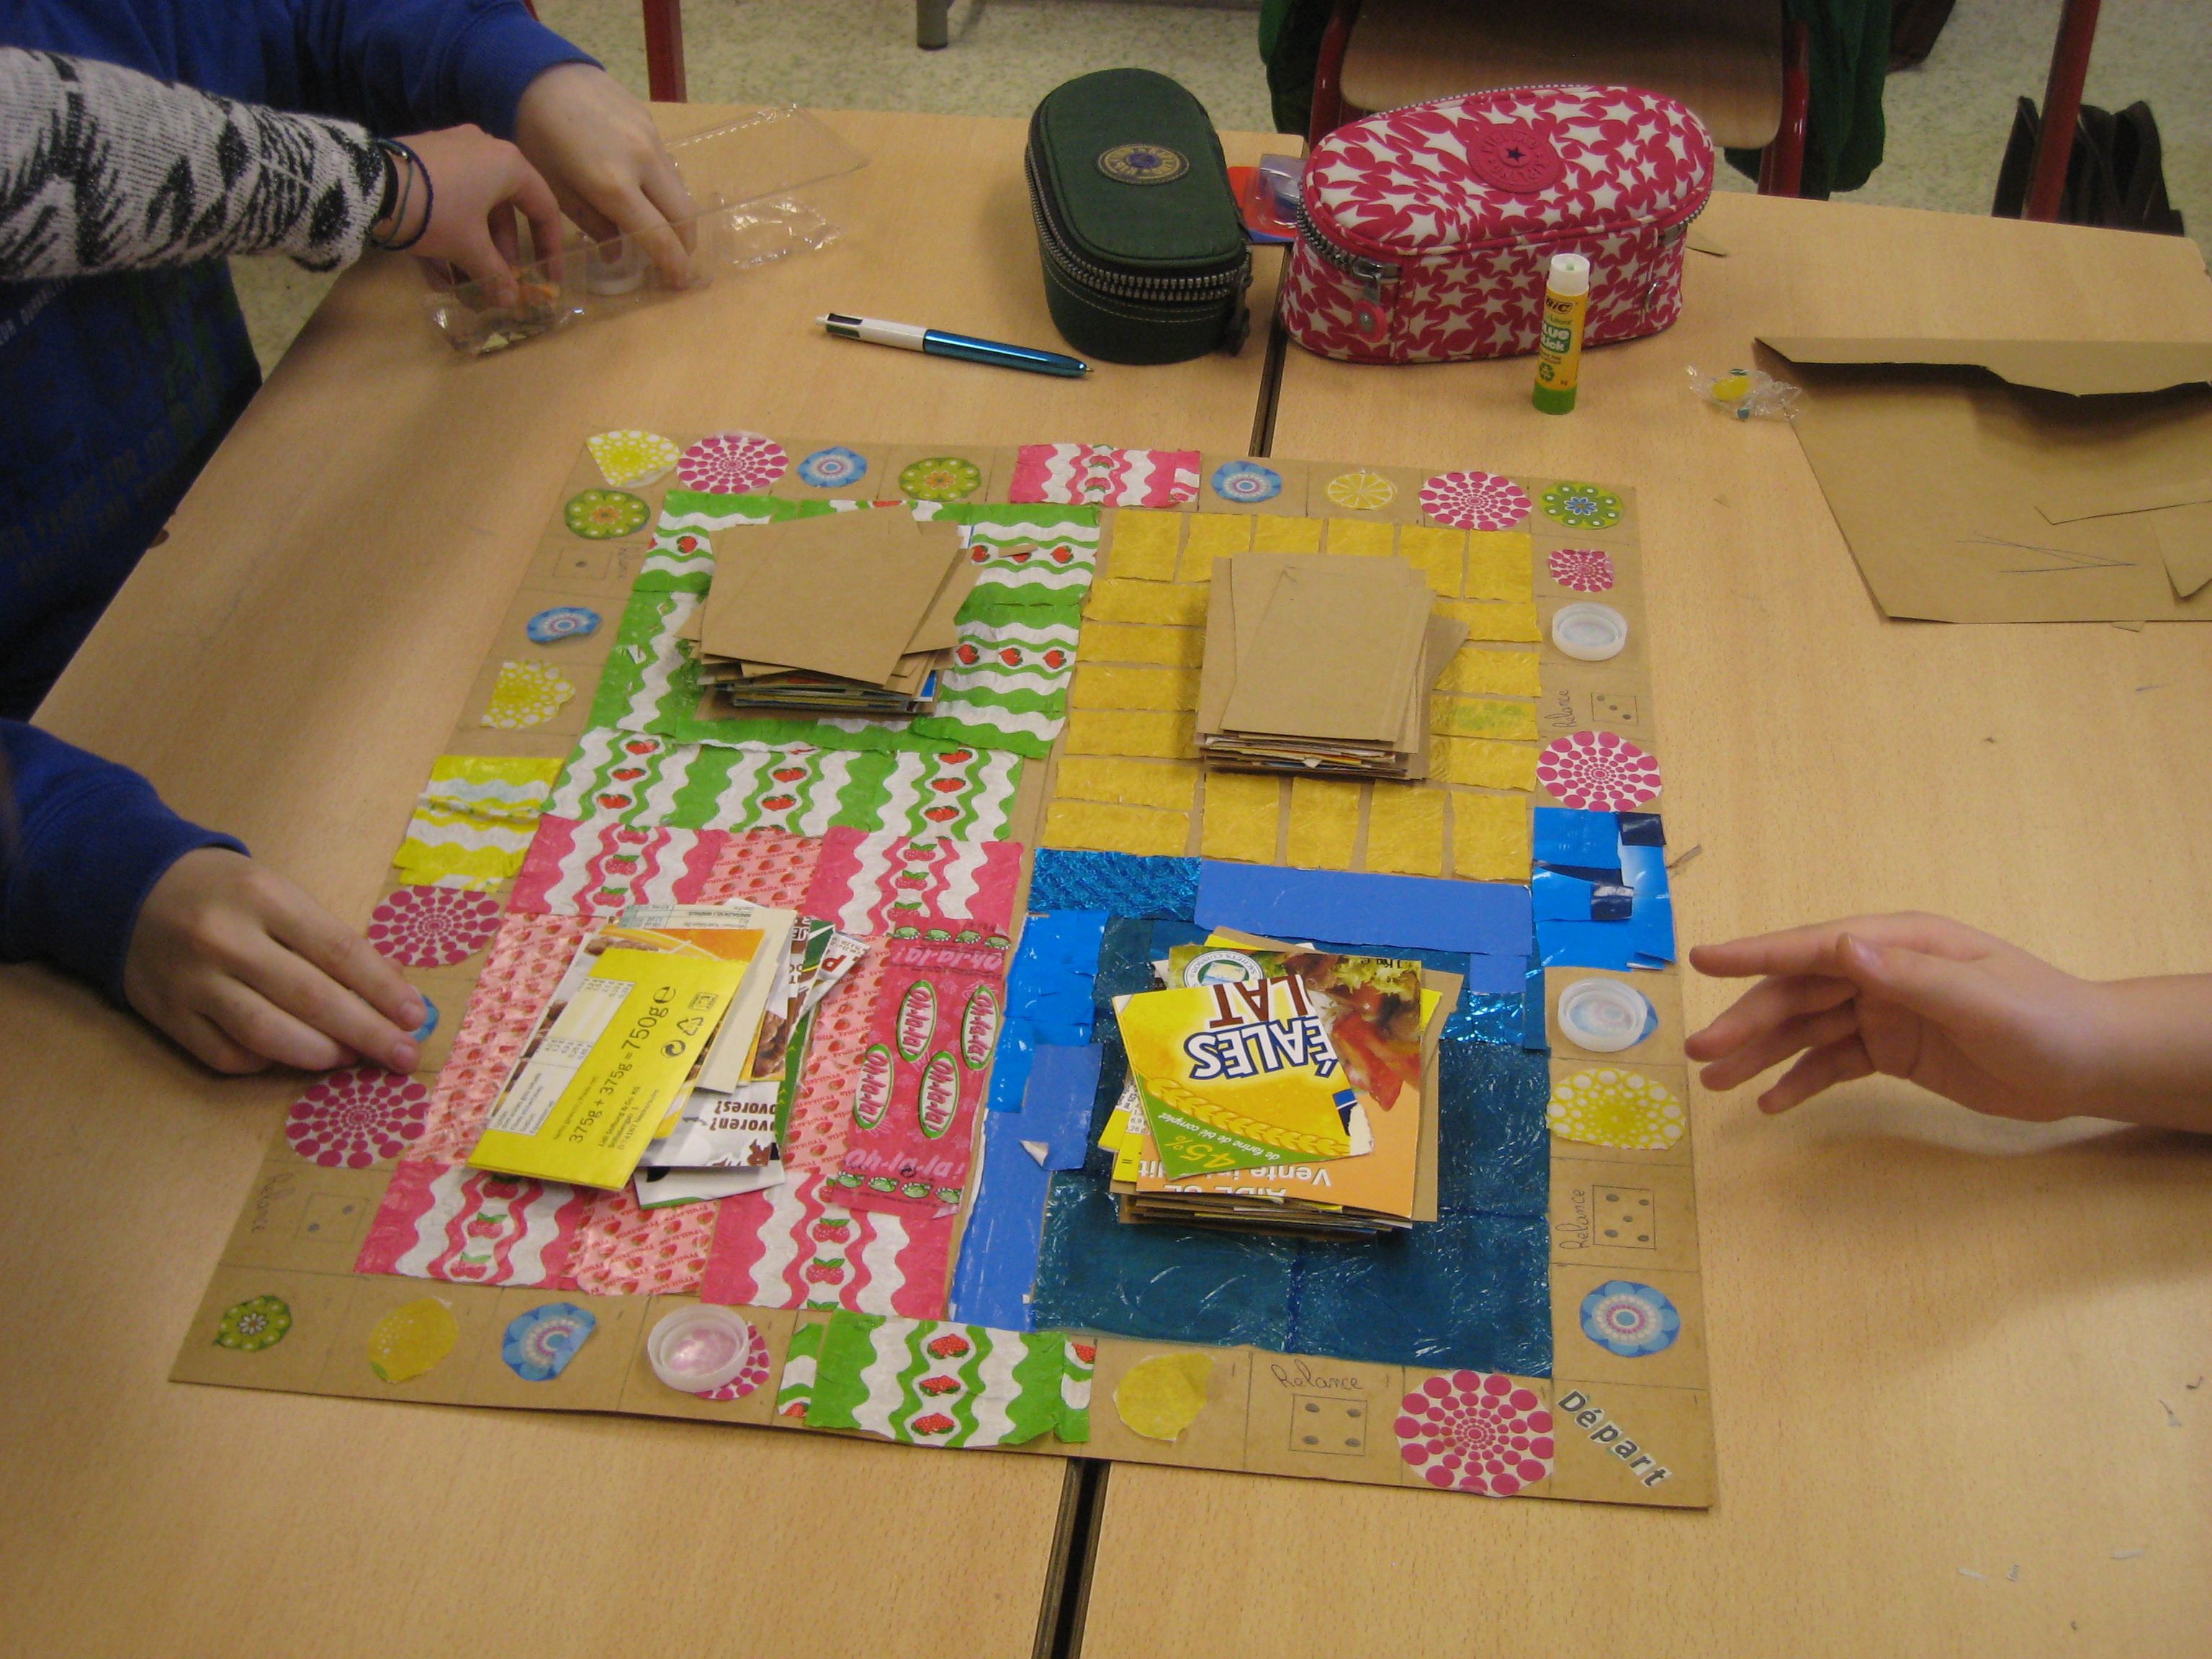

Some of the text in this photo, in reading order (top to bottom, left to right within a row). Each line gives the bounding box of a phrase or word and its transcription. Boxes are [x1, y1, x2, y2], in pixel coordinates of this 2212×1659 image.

[1226, 953, 1257, 975] SACHETS
[902, 988, 932, 1056] Oh-la-la!
[966, 994, 994, 1065] Oh-la-la!
[1209, 975, 1308, 1028] LAT
[569, 1110, 603, 1143] 375g
[600, 1064, 633, 1095] 375g
[621, 1007, 669, 1051] 750g
[1184, 1014, 1339, 1081] ÉALES
[858, 1052, 889, 1123] Oh-la-la!
[924, 1060, 956, 1131] Oh-la-la!
[1157, 1112, 1280, 1161] de farine de blé complet
[1249, 1164, 1332, 1187] Vente
[1271, 1359, 1364, 1390] Relance
[1557, 1389, 1672, 1488] Départ
